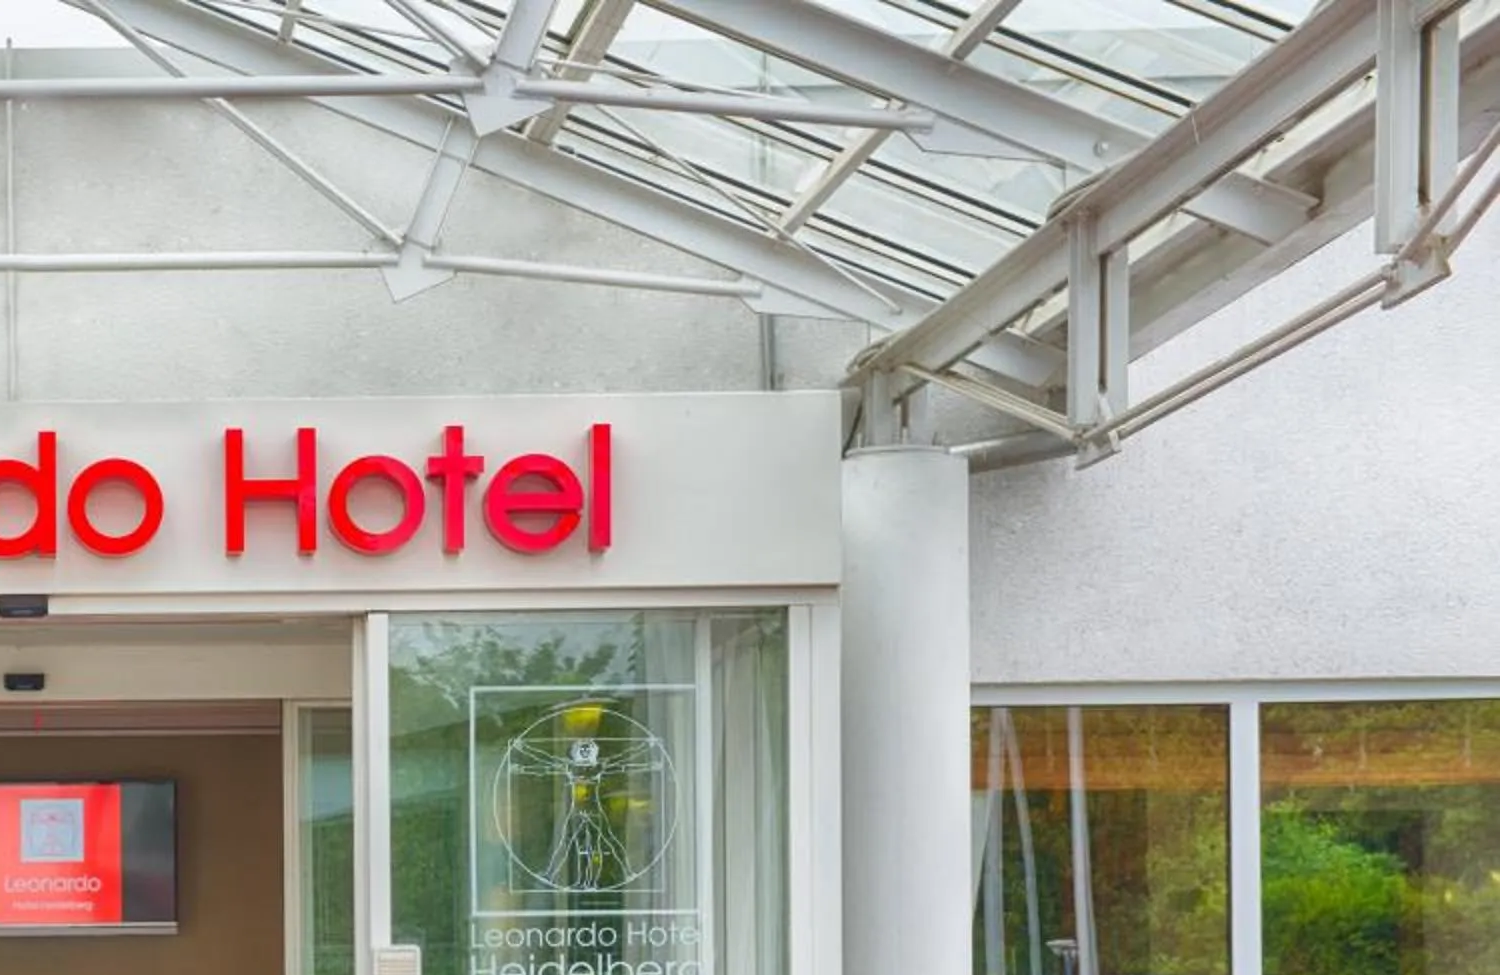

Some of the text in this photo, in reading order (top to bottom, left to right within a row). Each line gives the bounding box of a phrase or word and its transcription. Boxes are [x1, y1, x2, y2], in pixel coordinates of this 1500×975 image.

[223, 423, 612, 556] Hotel
[4, 874, 101, 893] Leonardo
[471, 920, 703, 948] Leonardo Hote
